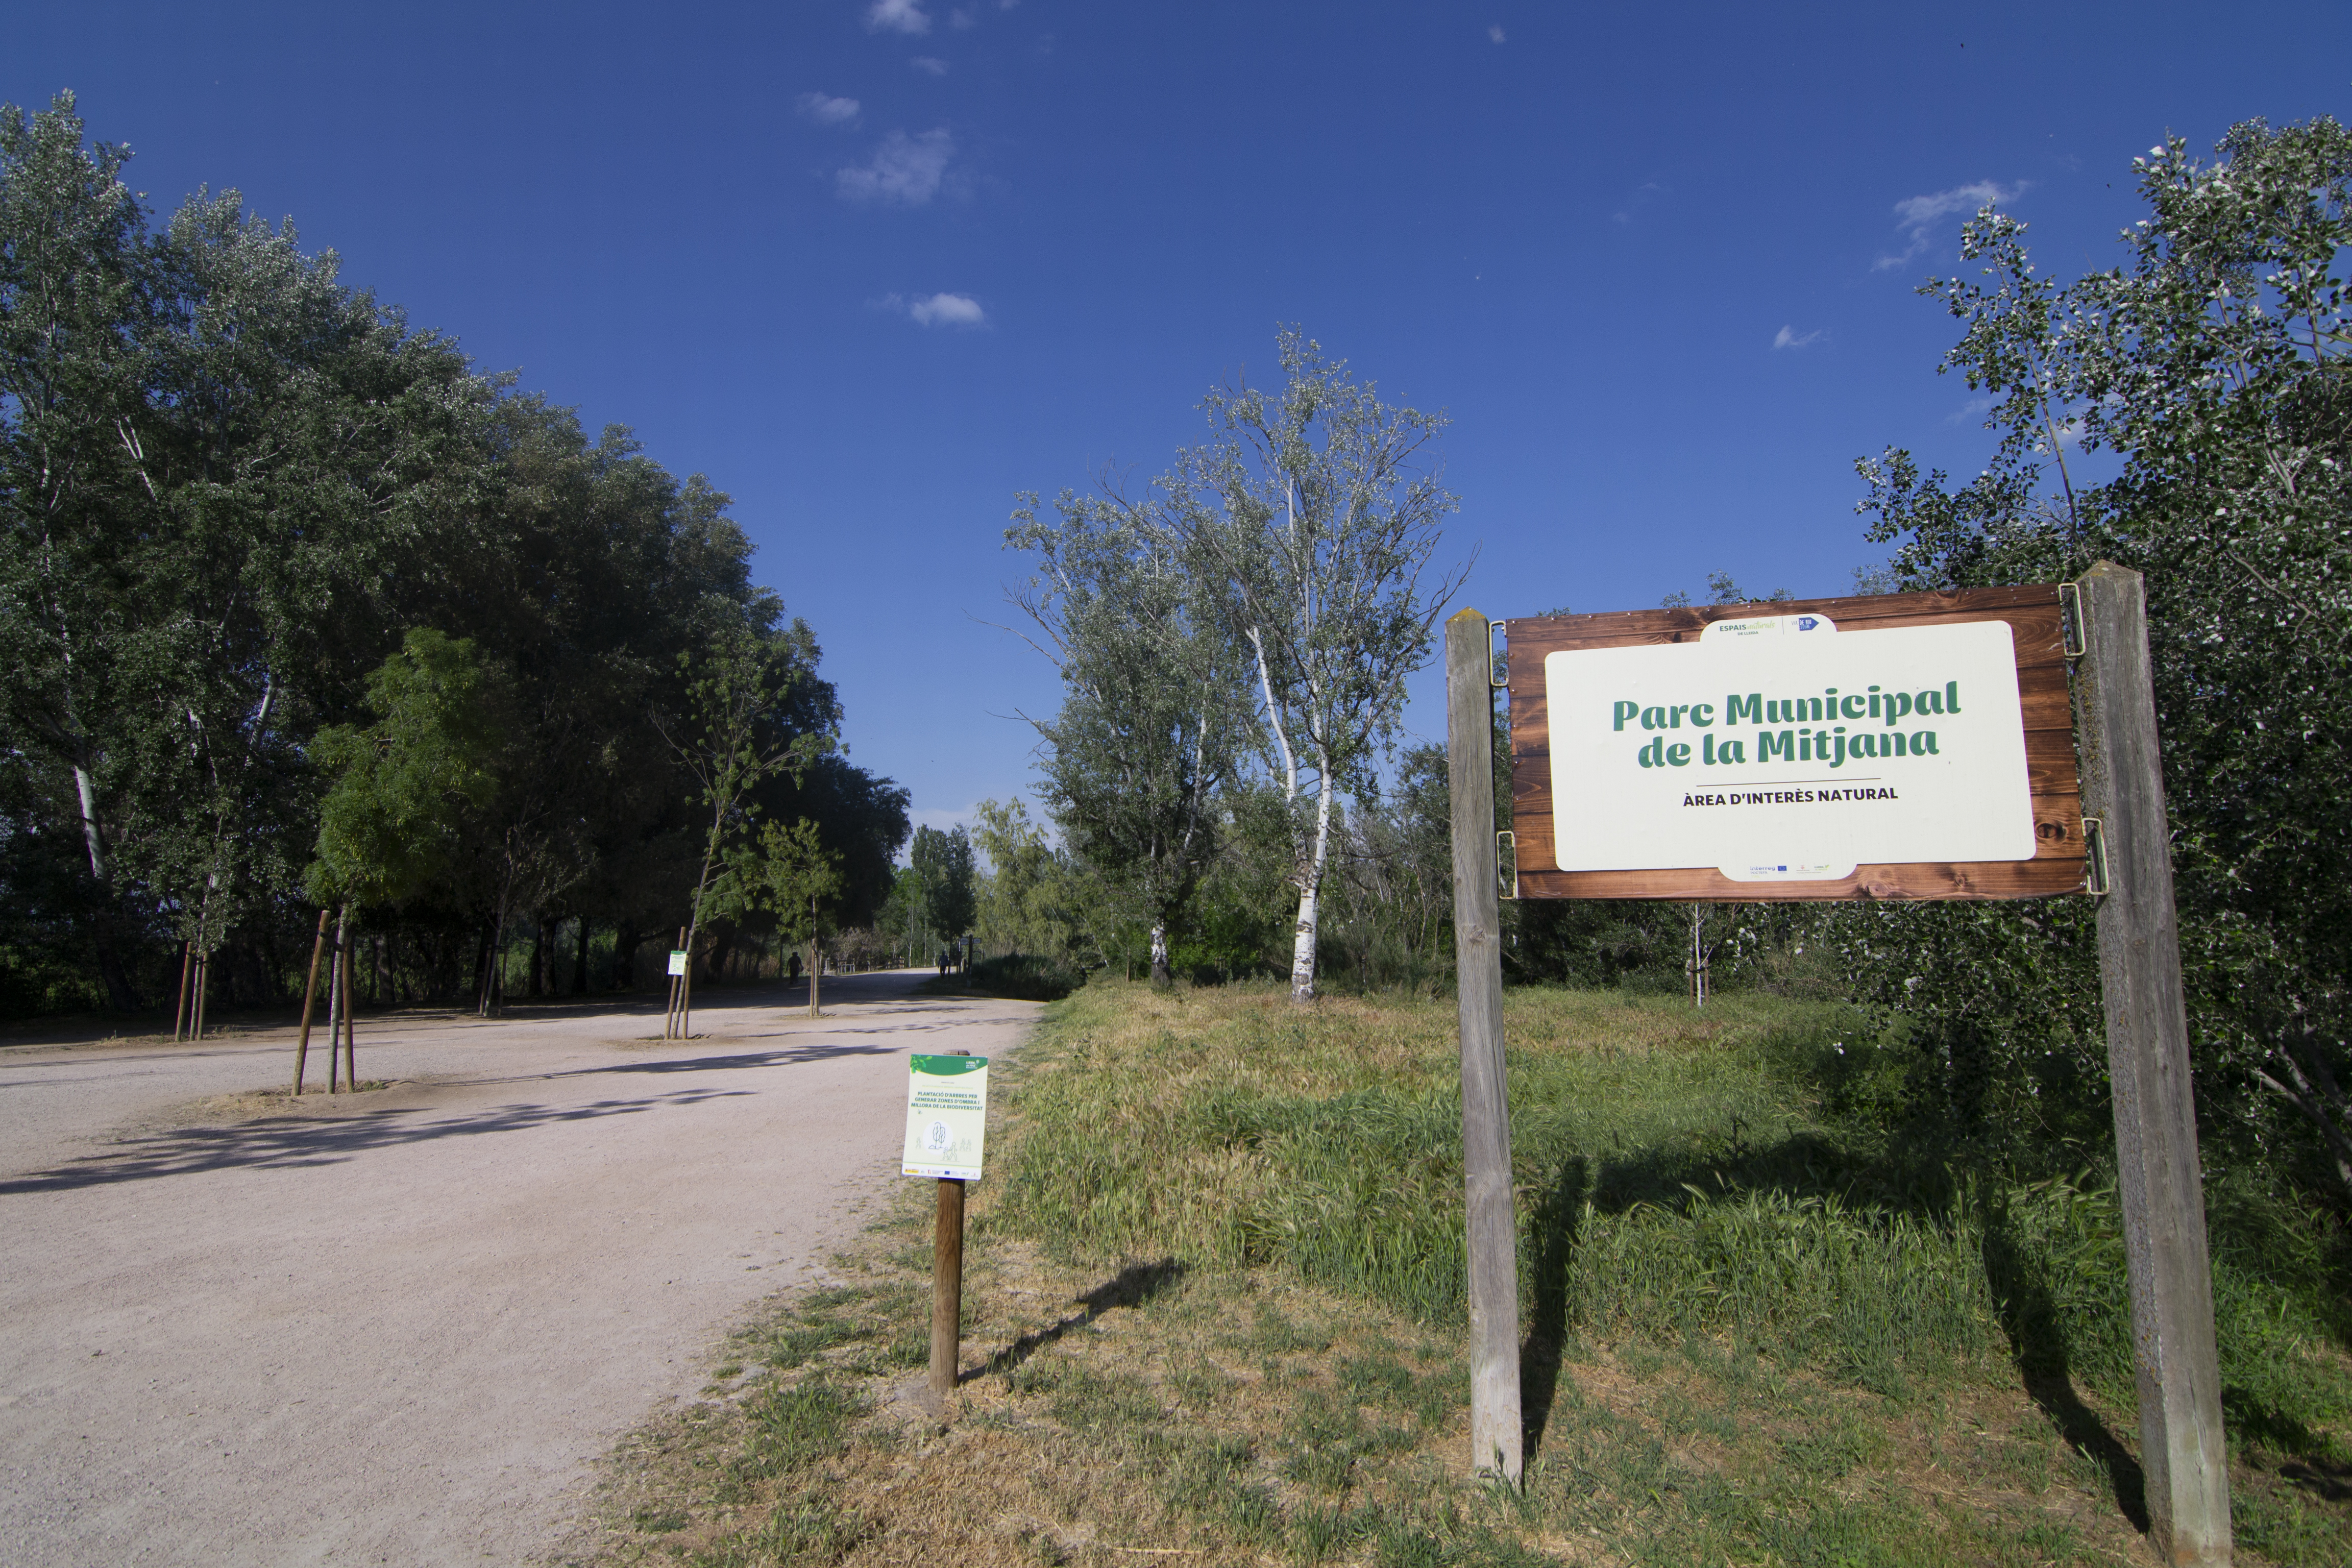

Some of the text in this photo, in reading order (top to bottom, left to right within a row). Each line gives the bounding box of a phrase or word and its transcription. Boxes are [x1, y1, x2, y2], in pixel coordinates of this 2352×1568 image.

[1747, 620, 1776, 630] naturals
[1613, 681, 1961, 731] Parc Municipal
[1637, 726, 1940, 769] de la Mitjana
[1683, 787, 1898, 806] ÀREA D'INTERÈS NATURAL
